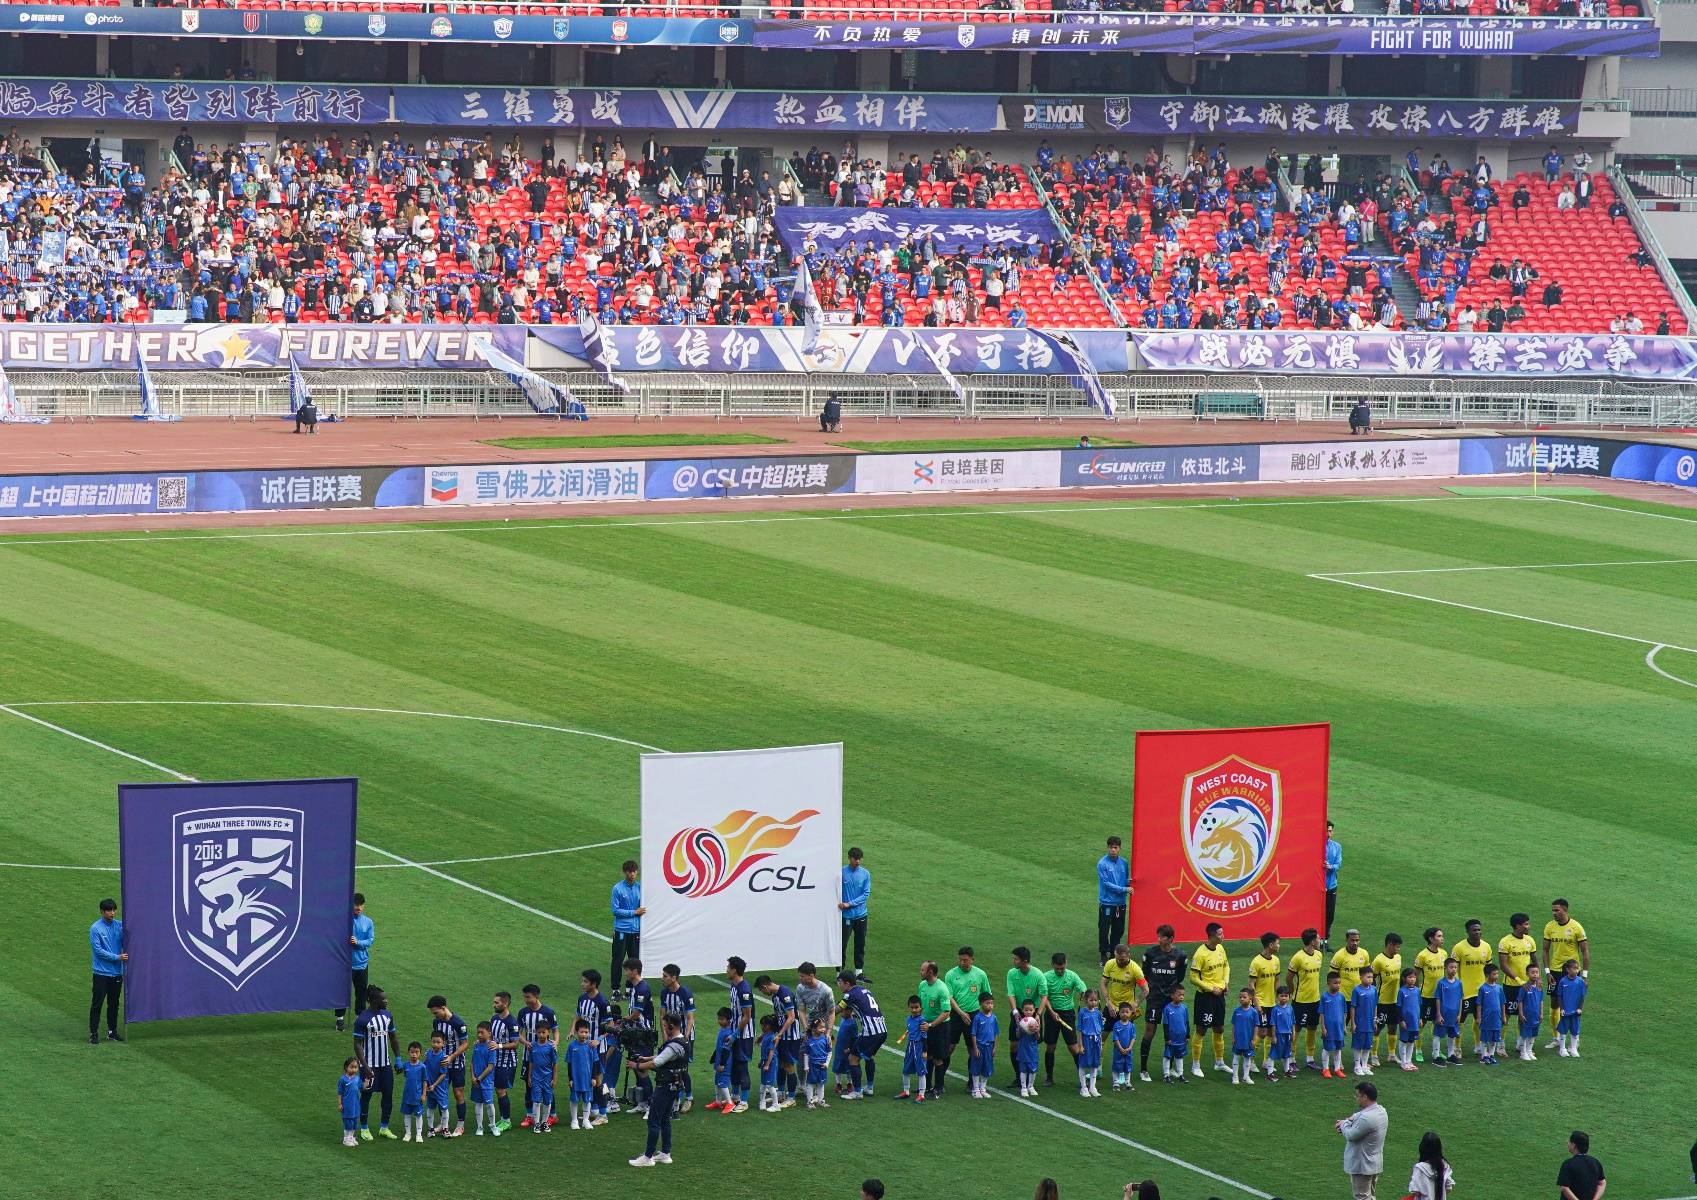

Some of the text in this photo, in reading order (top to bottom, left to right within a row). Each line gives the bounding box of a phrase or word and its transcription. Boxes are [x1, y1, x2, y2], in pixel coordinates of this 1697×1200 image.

[814, 25, 1121, 45] 不负热爱 镇创未来
[1371, 30, 1514, 49] FIGHT FOR WUHAN
[0, 81, 364, 122] 临兵斗者皆列阵前行
[460, 88, 623, 126] 三镇勇战
[773, 93, 928, 129] 热血相伴
[1023, 104, 1085, 123] DEMON
[1159, 100, 1354, 134] 守御江城荣耀
[0, 330, 493, 362] GETHER FOREVER
[1199, 333, 1638, 373] 战必无惧 锋芒必争
[1181, 456, 1246, 477] 依迅北斗
[1291, 453, 1320, 471] 融创
[1505, 442, 1600, 471] 诚信联赛
[431, 470, 458, 478] Chevron
[940, 459, 1004, 476] 良培基因
[260, 474, 362, 504] 诚信联赛
[475, 467, 639, 499] 雪佛龙润滑油
[23, 483, 153, 508] 上中国移动咪咕
[1196, 773, 1268, 794] WEST COAST
[1193, 786, 1271, 815] TRUE WARRIOR
[194, 820, 282, 830] WUHAN THREE TOWNS FC
[194, 844, 223, 861] 2013
[749, 865, 816, 893] CSL
[1196, 892, 1260, 912] SINCE 2007
[868, 993, 879, 1012] 4
[1464, 1000, 1470, 1008] 9
[1507, 1001, 1518, 1010] 20
[1202, 1013, 1213, 1023] 36
[1301, 1013, 1308, 1022] 2
